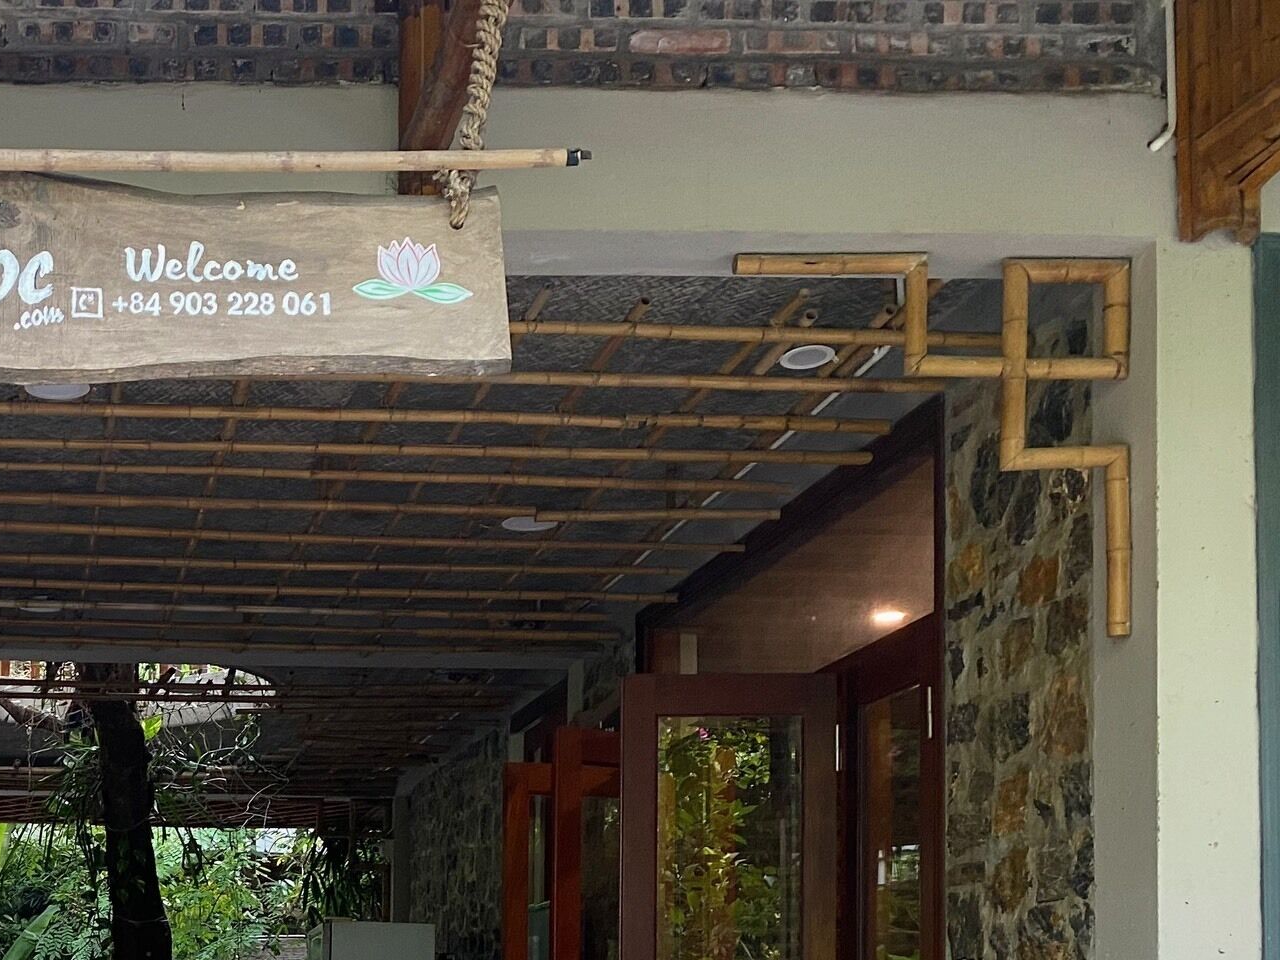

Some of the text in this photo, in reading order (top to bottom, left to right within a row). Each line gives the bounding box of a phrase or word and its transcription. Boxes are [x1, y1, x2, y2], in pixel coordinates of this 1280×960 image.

[125, 240, 299, 282] Welcome
[112, 292, 331, 315] +84 903 228 061
[13, 305, 64, 331] .com
